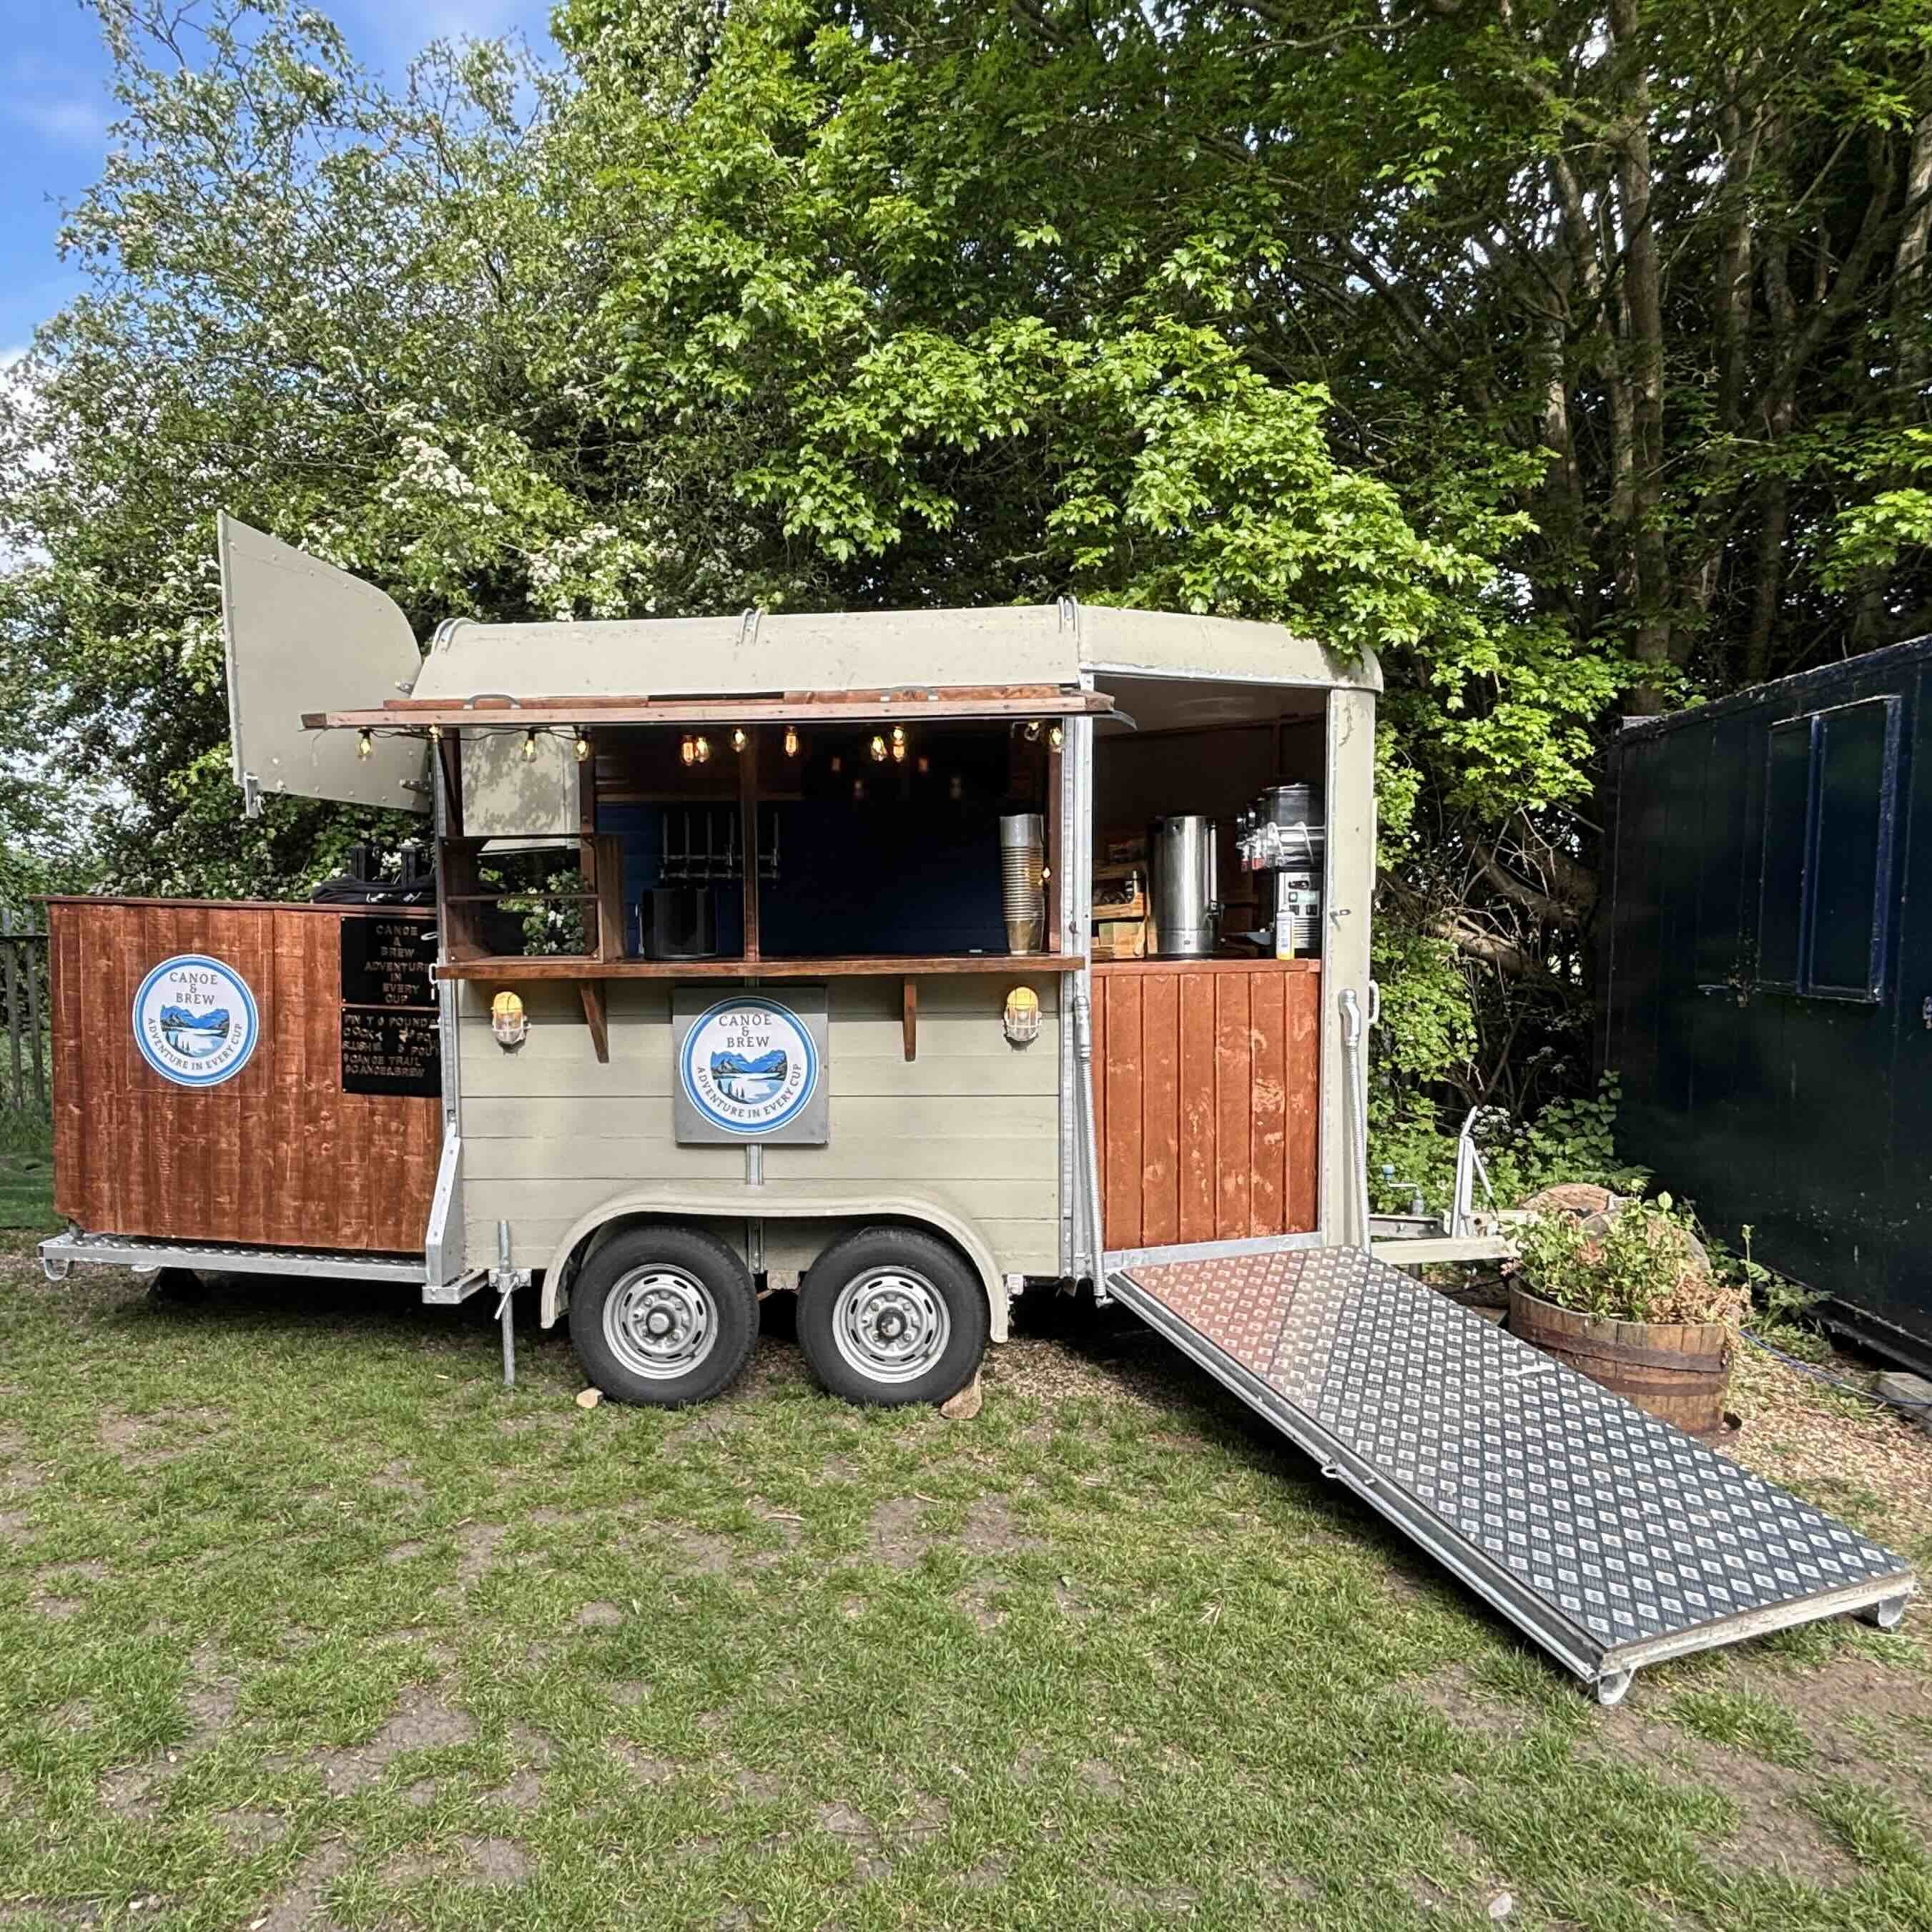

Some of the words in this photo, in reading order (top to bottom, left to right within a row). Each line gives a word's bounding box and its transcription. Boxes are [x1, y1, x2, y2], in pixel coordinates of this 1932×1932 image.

[376, 925, 418, 936] CANOE
[380, 946, 415, 958] BREW
[170, 972, 218, 985] CANOE
[390, 972, 402, 982] IN
[189, 983, 197, 994] &
[382, 982, 420, 995] EVERY
[176, 992, 215, 1005] BREW
[385, 993, 408, 1004] CUP
[719, 1013, 772, 1027] CANOE
[741, 1026, 749, 1037] &
[148, 1017, 188, 1070] ADVENTURE
[204, 1048, 235, 1069] EVERY
[232, 1023, 243, 1045] CUP
[726, 1036, 769, 1048] BREW
[698, 1067, 744, 1118] ADVENTURE
[746, 1109, 761, 1118] IN
[764, 1088, 794, 1115] EVERY
[789, 1063, 802, 1087] CUP
